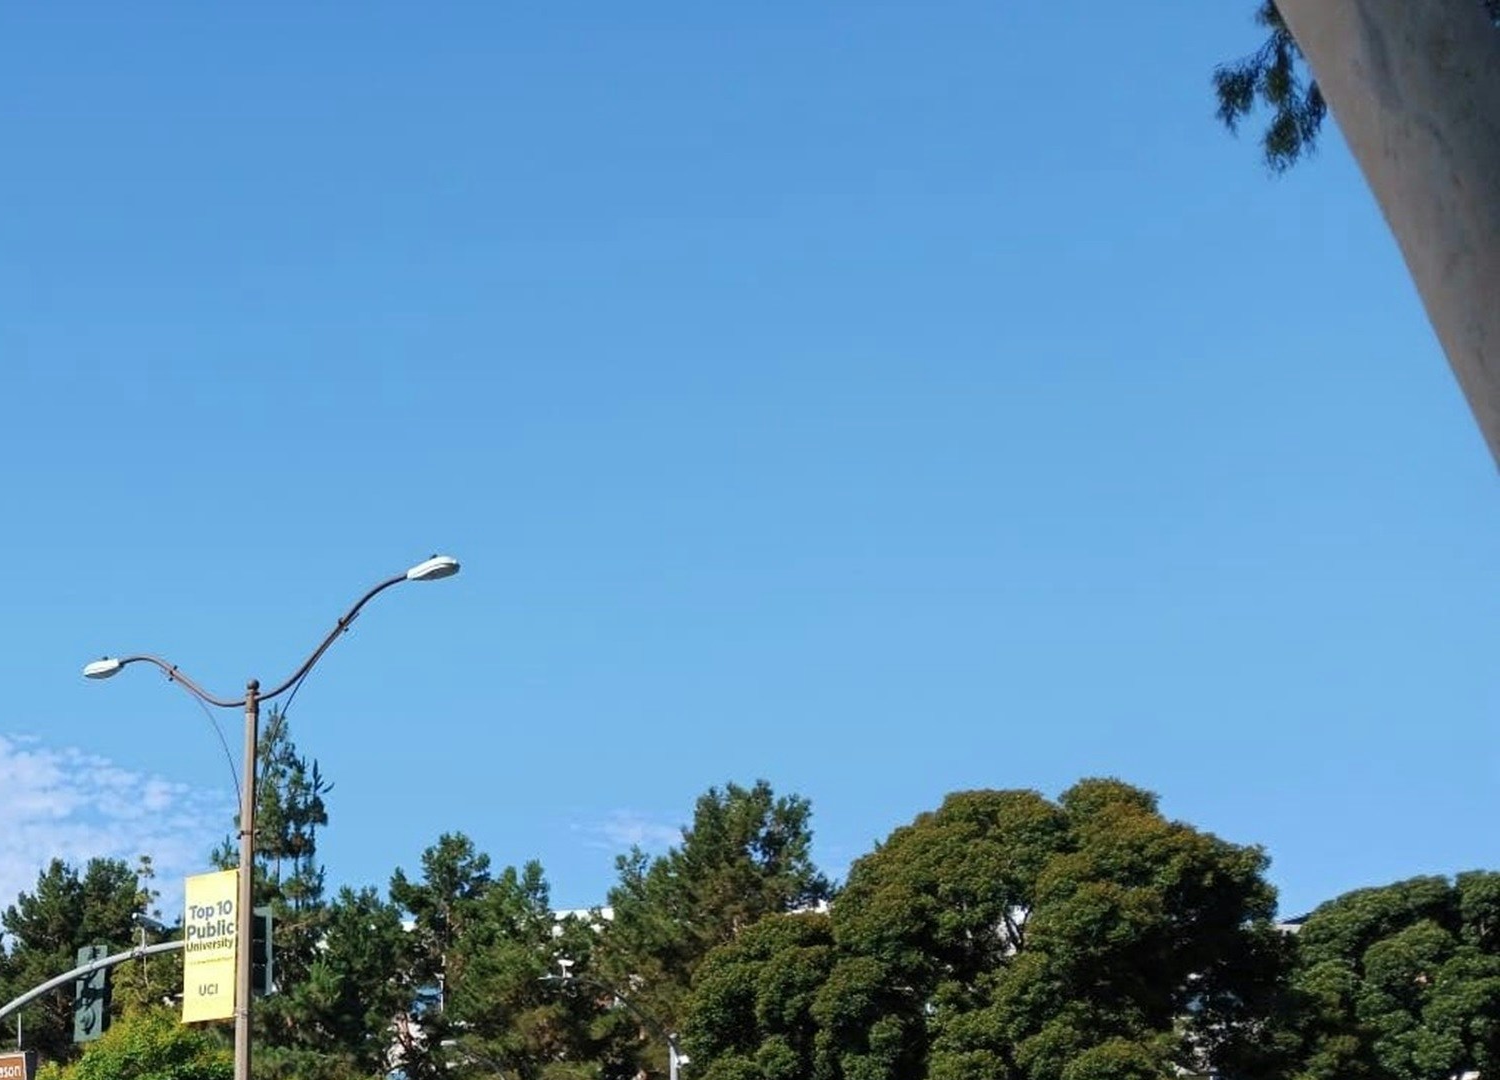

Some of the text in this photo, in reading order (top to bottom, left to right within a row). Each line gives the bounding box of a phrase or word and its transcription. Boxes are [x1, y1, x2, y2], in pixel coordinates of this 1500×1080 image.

[189, 900, 233, 921] Top 10
[187, 919, 235, 941] Public
[186, 937, 234, 952] University
[199, 983, 219, 996] UCI
